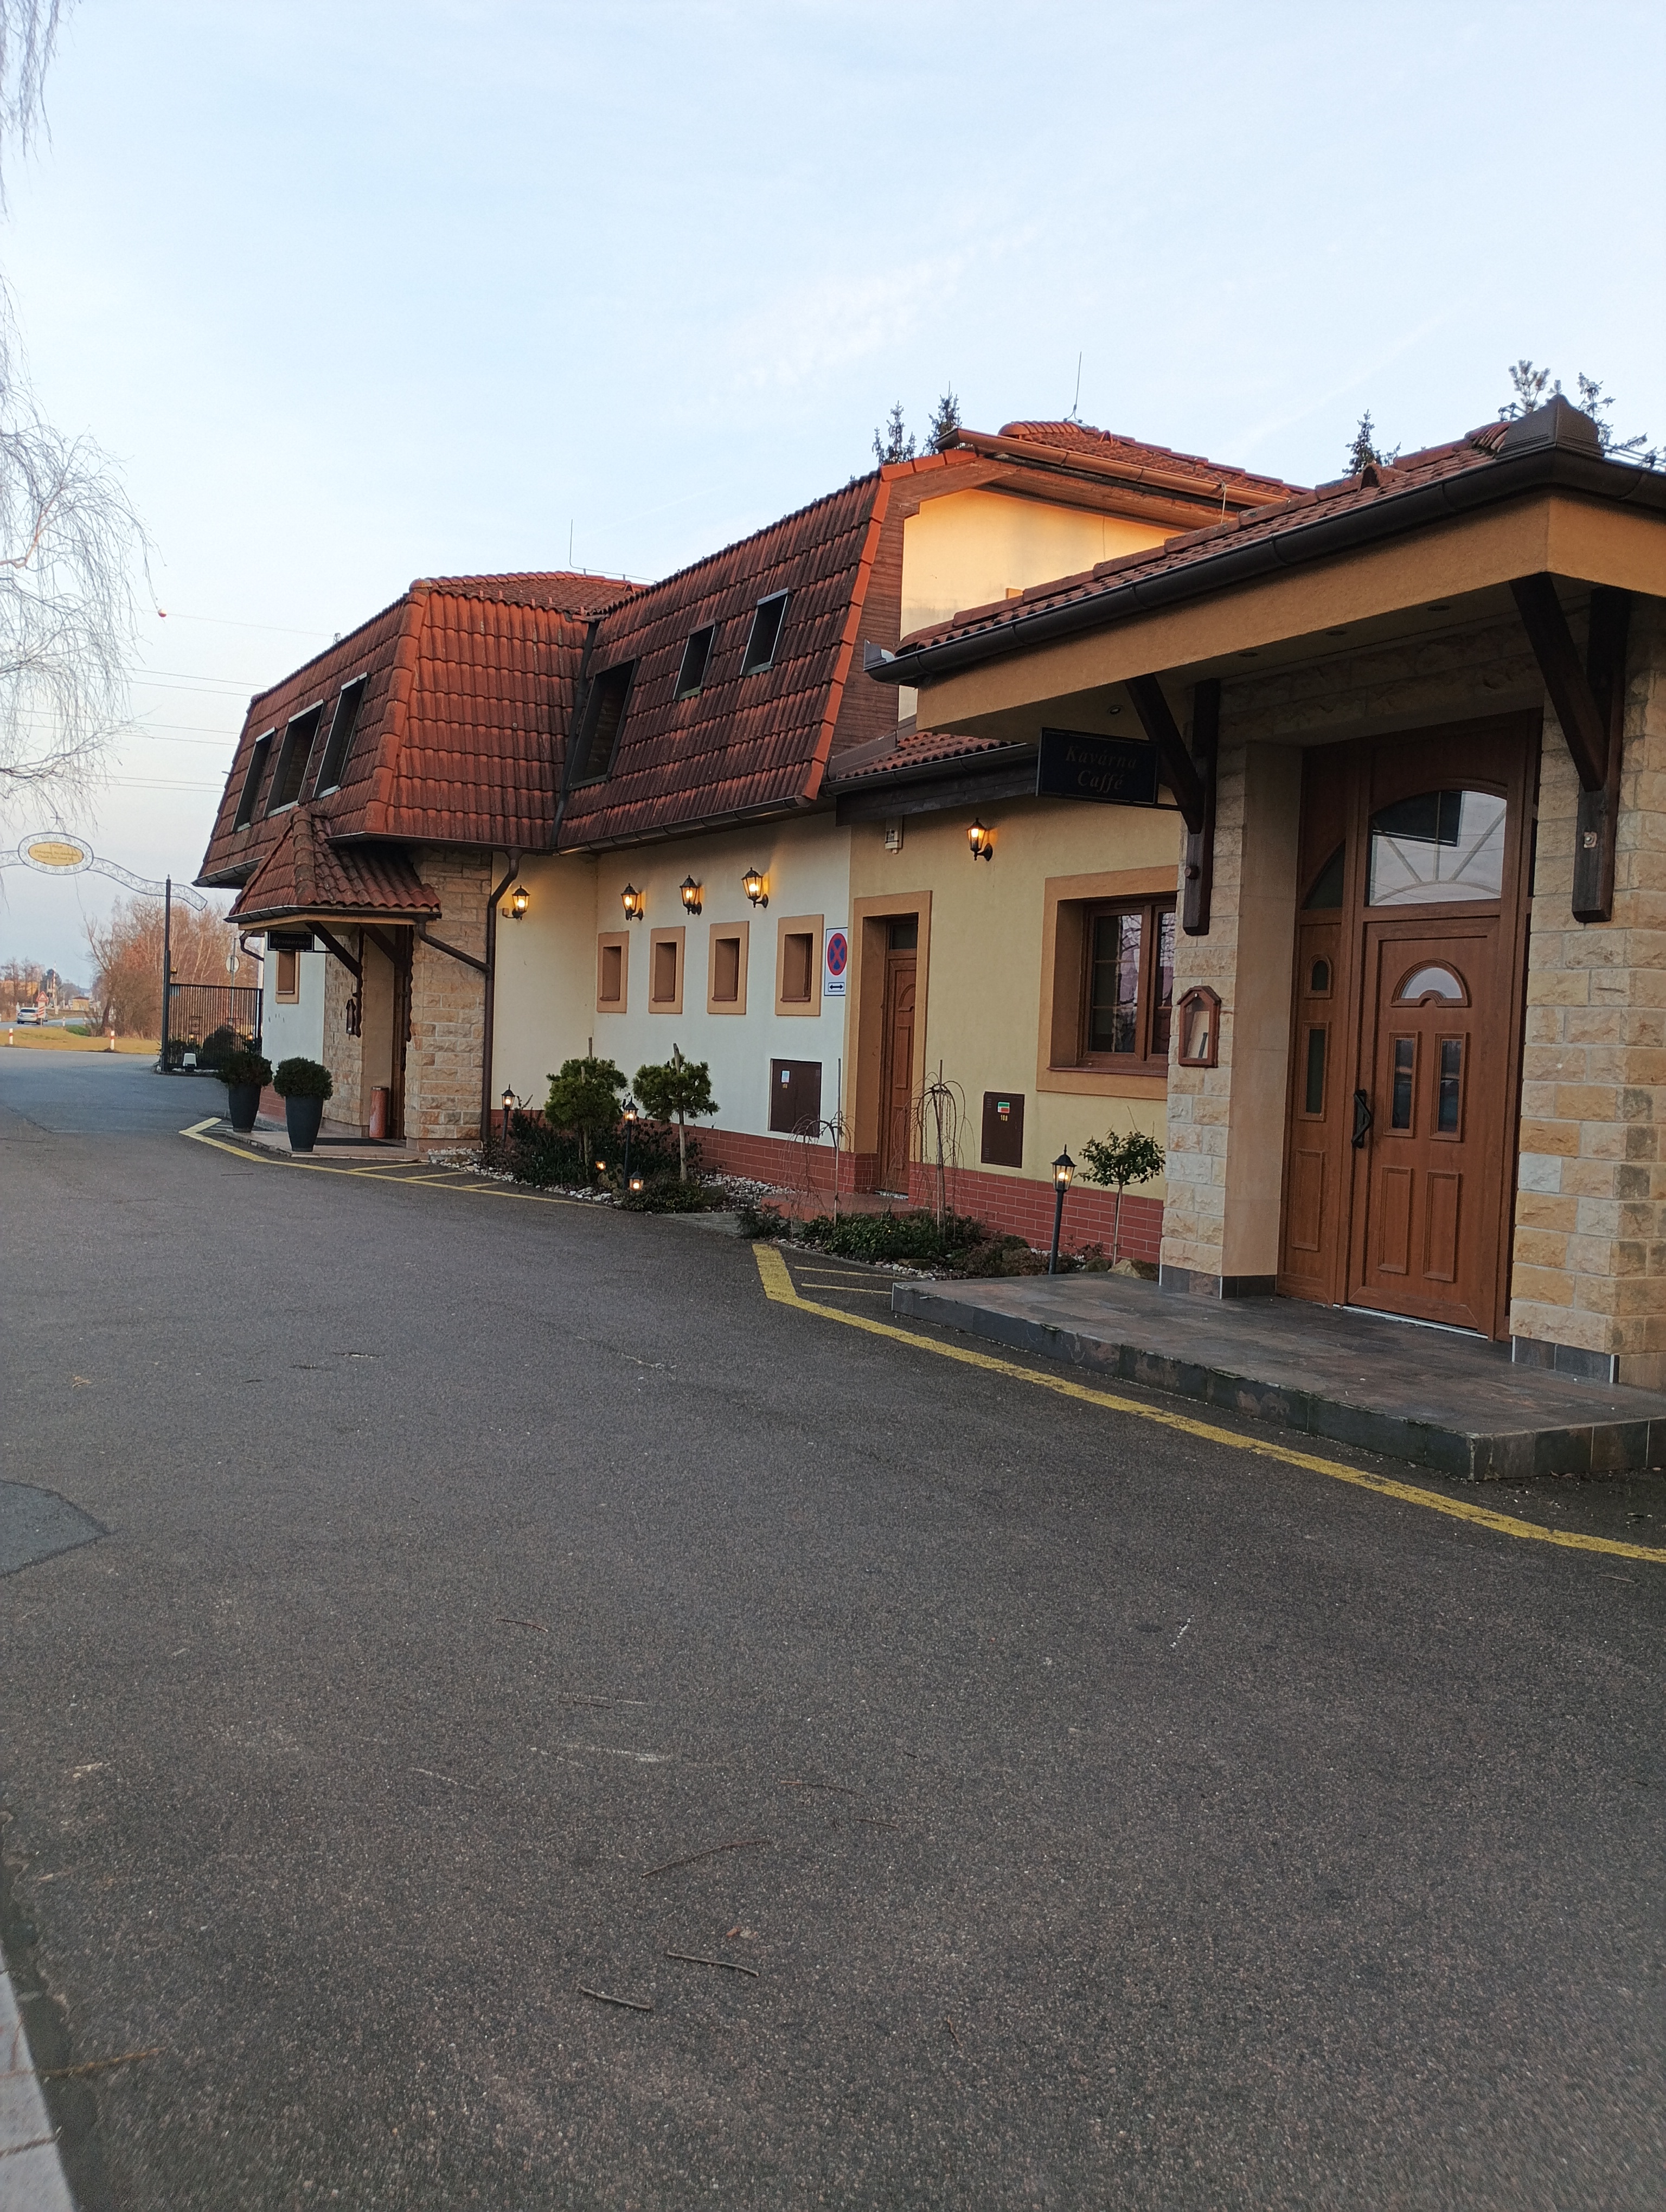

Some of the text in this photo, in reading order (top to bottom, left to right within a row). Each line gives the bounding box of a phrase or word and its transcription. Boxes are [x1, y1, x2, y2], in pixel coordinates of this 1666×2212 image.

[1065, 745, 1137, 769] Kavárna
[1078, 770, 1124, 794] Caffé
[273, 937, 311, 946] Restaurace
